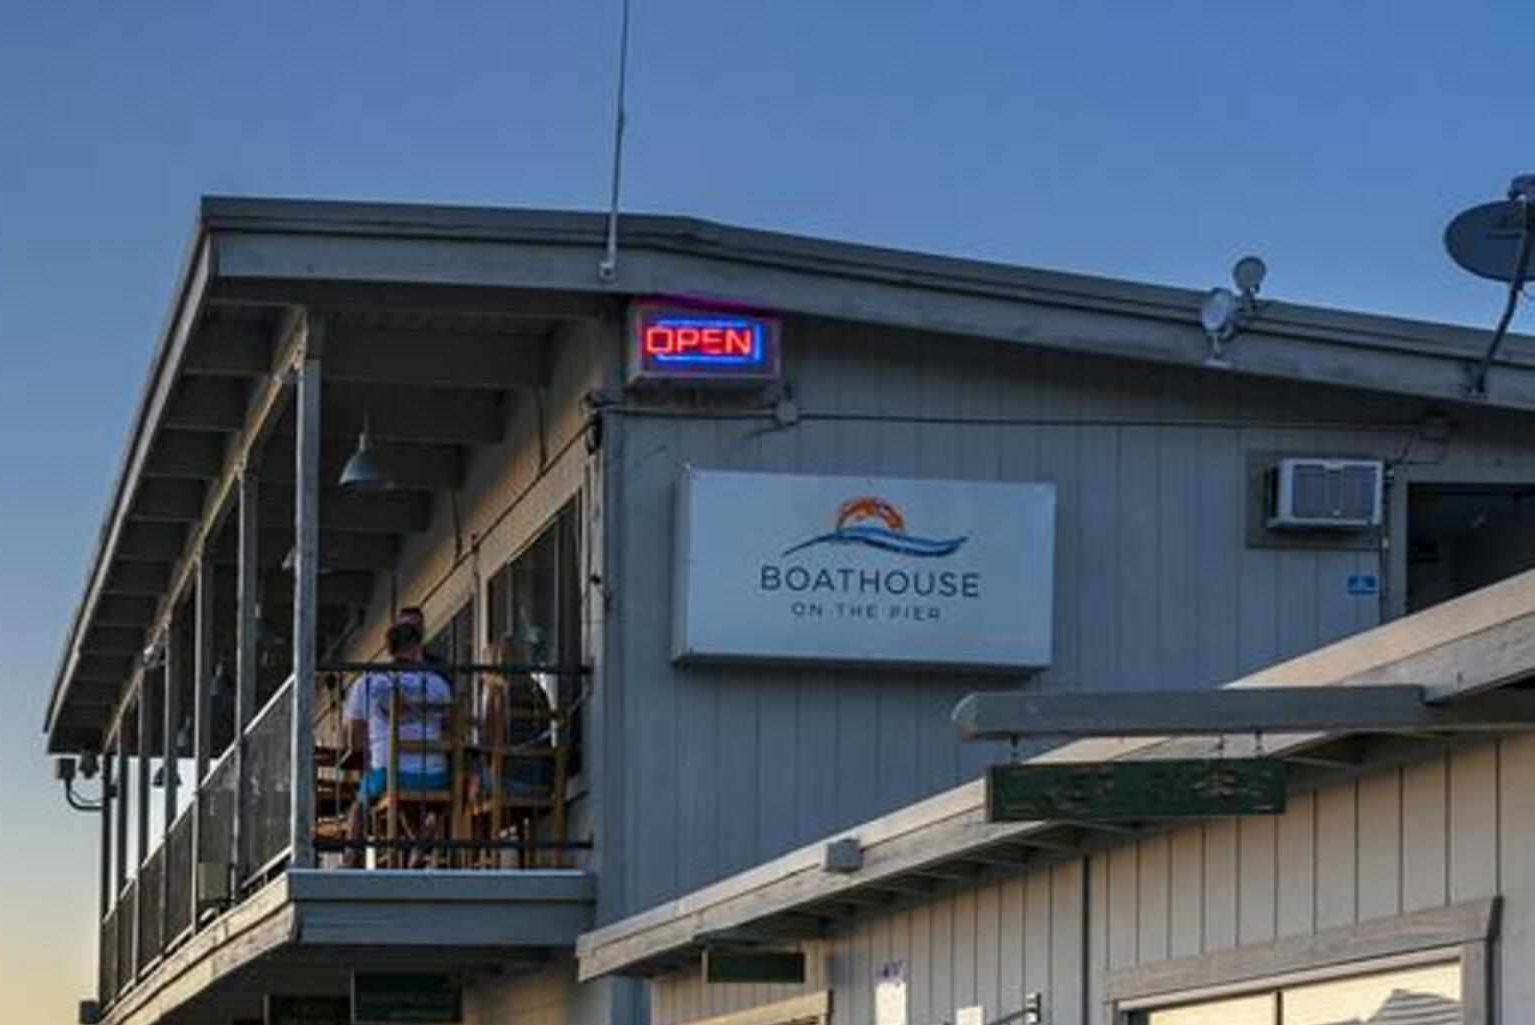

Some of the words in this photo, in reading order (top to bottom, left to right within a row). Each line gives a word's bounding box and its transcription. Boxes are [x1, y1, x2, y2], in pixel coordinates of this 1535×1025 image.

[646, 327, 751, 354] OPEN
[760, 565, 981, 598] BOATHOUSE
[790, 601, 823, 617] ON
[836, 602, 878, 619] THE
[889, 604, 942, 621] PIER
